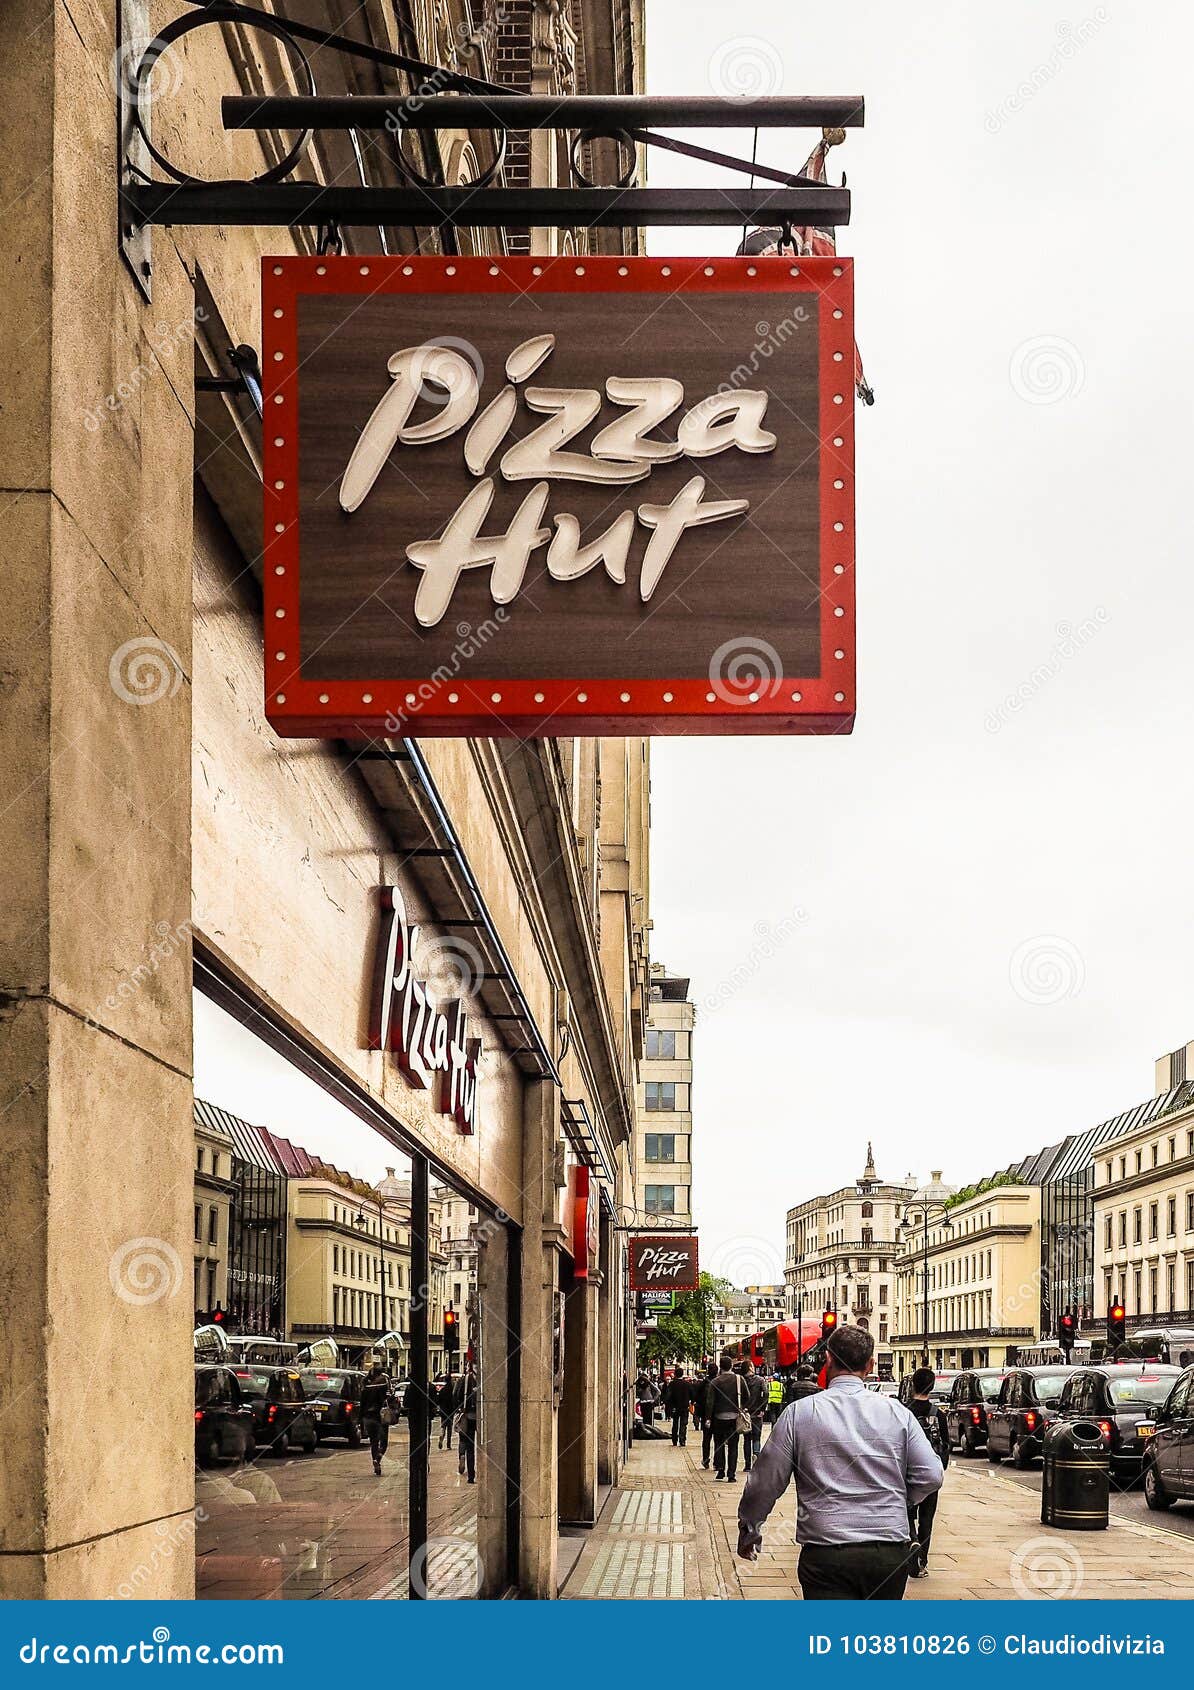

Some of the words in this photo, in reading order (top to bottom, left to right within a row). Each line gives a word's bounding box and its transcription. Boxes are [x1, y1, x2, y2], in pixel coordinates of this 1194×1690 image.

[339, 334, 777, 513] Pizza
[405, 475, 750, 627] Hut
[374, 885, 449, 1090] Pizza
[638, 1246, 690, 1267] Pizza
[645, 1262, 687, 1281] Hut
